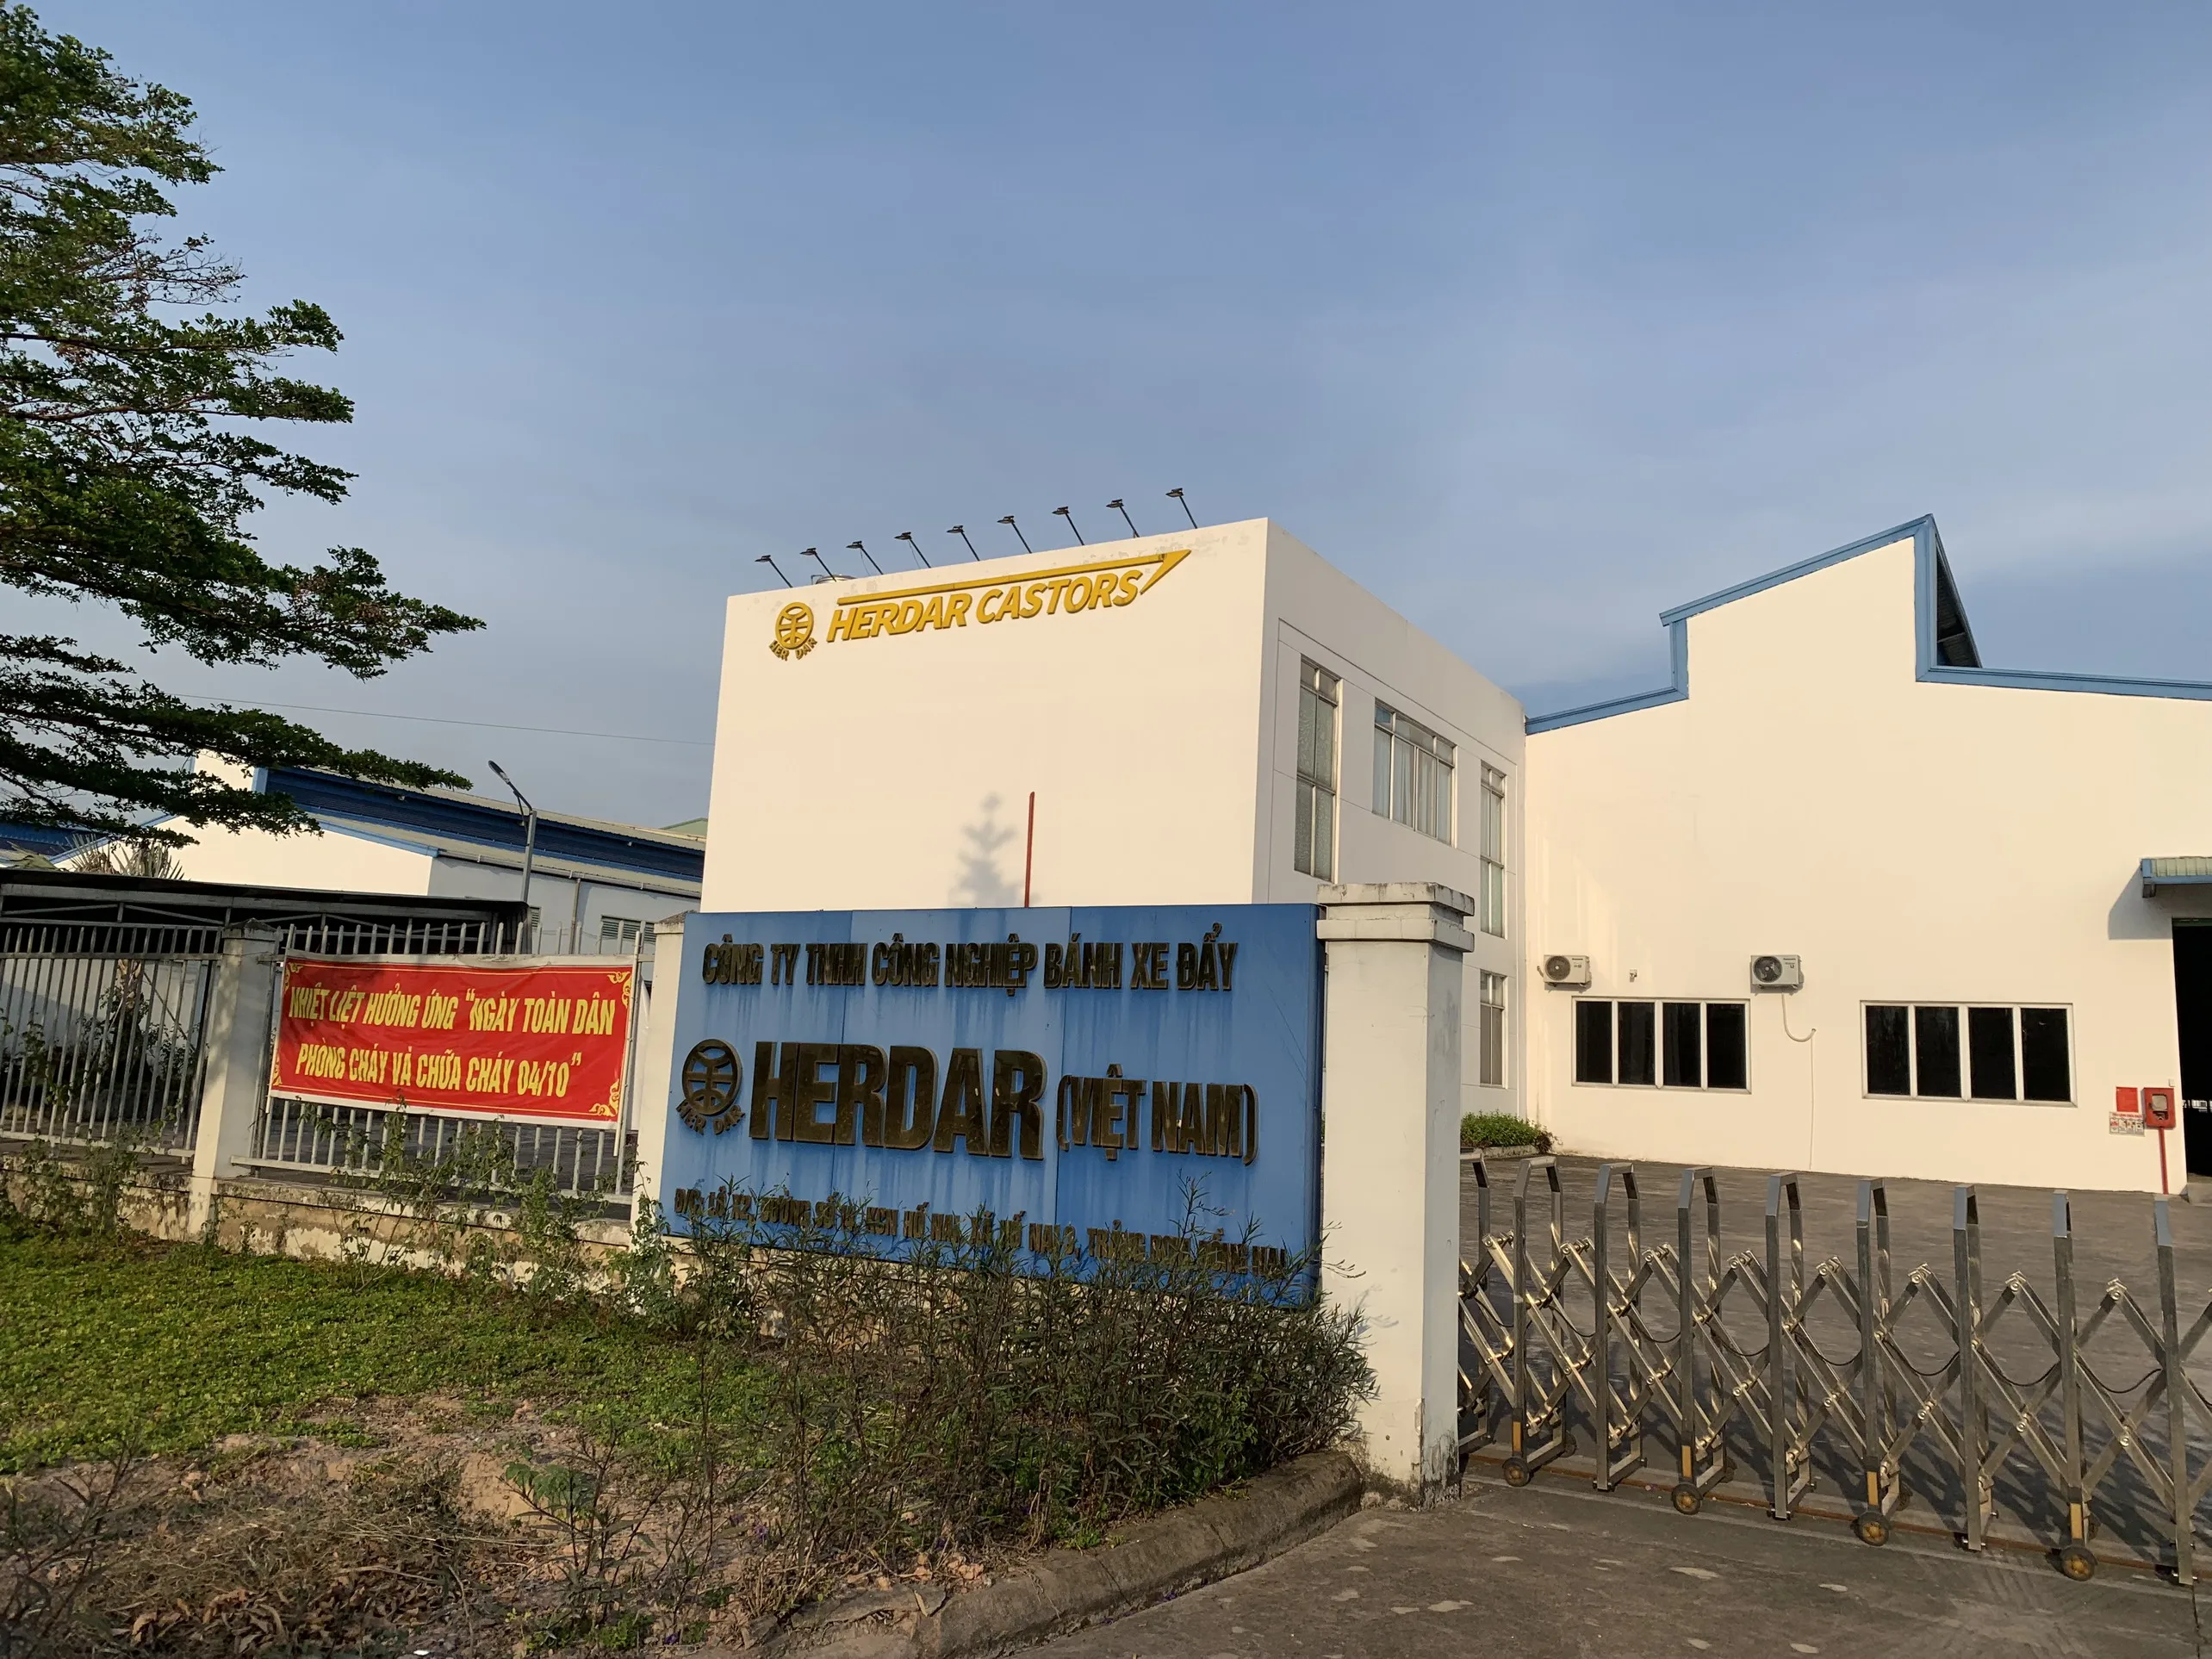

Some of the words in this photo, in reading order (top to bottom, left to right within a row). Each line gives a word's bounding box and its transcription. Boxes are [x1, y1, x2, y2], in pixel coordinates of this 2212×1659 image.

[826, 593, 972, 643] HERDAR
[976, 569, 1144, 625] CASTORS
[702, 934, 764, 985] CÔNG
[770, 943, 800, 985] TY
[805, 943, 867, 986] TNHH
[872, 933, 940, 986] CÔNG
[944, 933, 1039, 997] NGHIỆP
[1044, 933, 1123, 989] BÁNH
[1131, 942, 1169, 990] XE
[1176, 923, 1238, 991] ĐẨY
[289, 982, 331, 1027] NHIỆT
[329, 985, 366, 1029] LIỆT
[363, 983, 421, 1028] HƯỞNG
[421, 988, 458, 1029] ỨNG
[522, 991, 571, 1034] TOÀN
[572, 991, 616, 1035] DÂN
[295, 1037, 346, 1079] PHÒNG
[349, 1043, 389, 1084] CHÁY
[392, 1046, 413, 1086] VÀ
[416, 1048, 462, 1090] CHỮA
[466, 1051, 514, 1094] CHÁY
[675, 1098, 706, 1135] HER
[749, 1041, 1048, 1161] HERDAR
[1056, 1063, 1147, 1160] (VIỆT
[1151, 1081, 1258, 1166] NAM)
